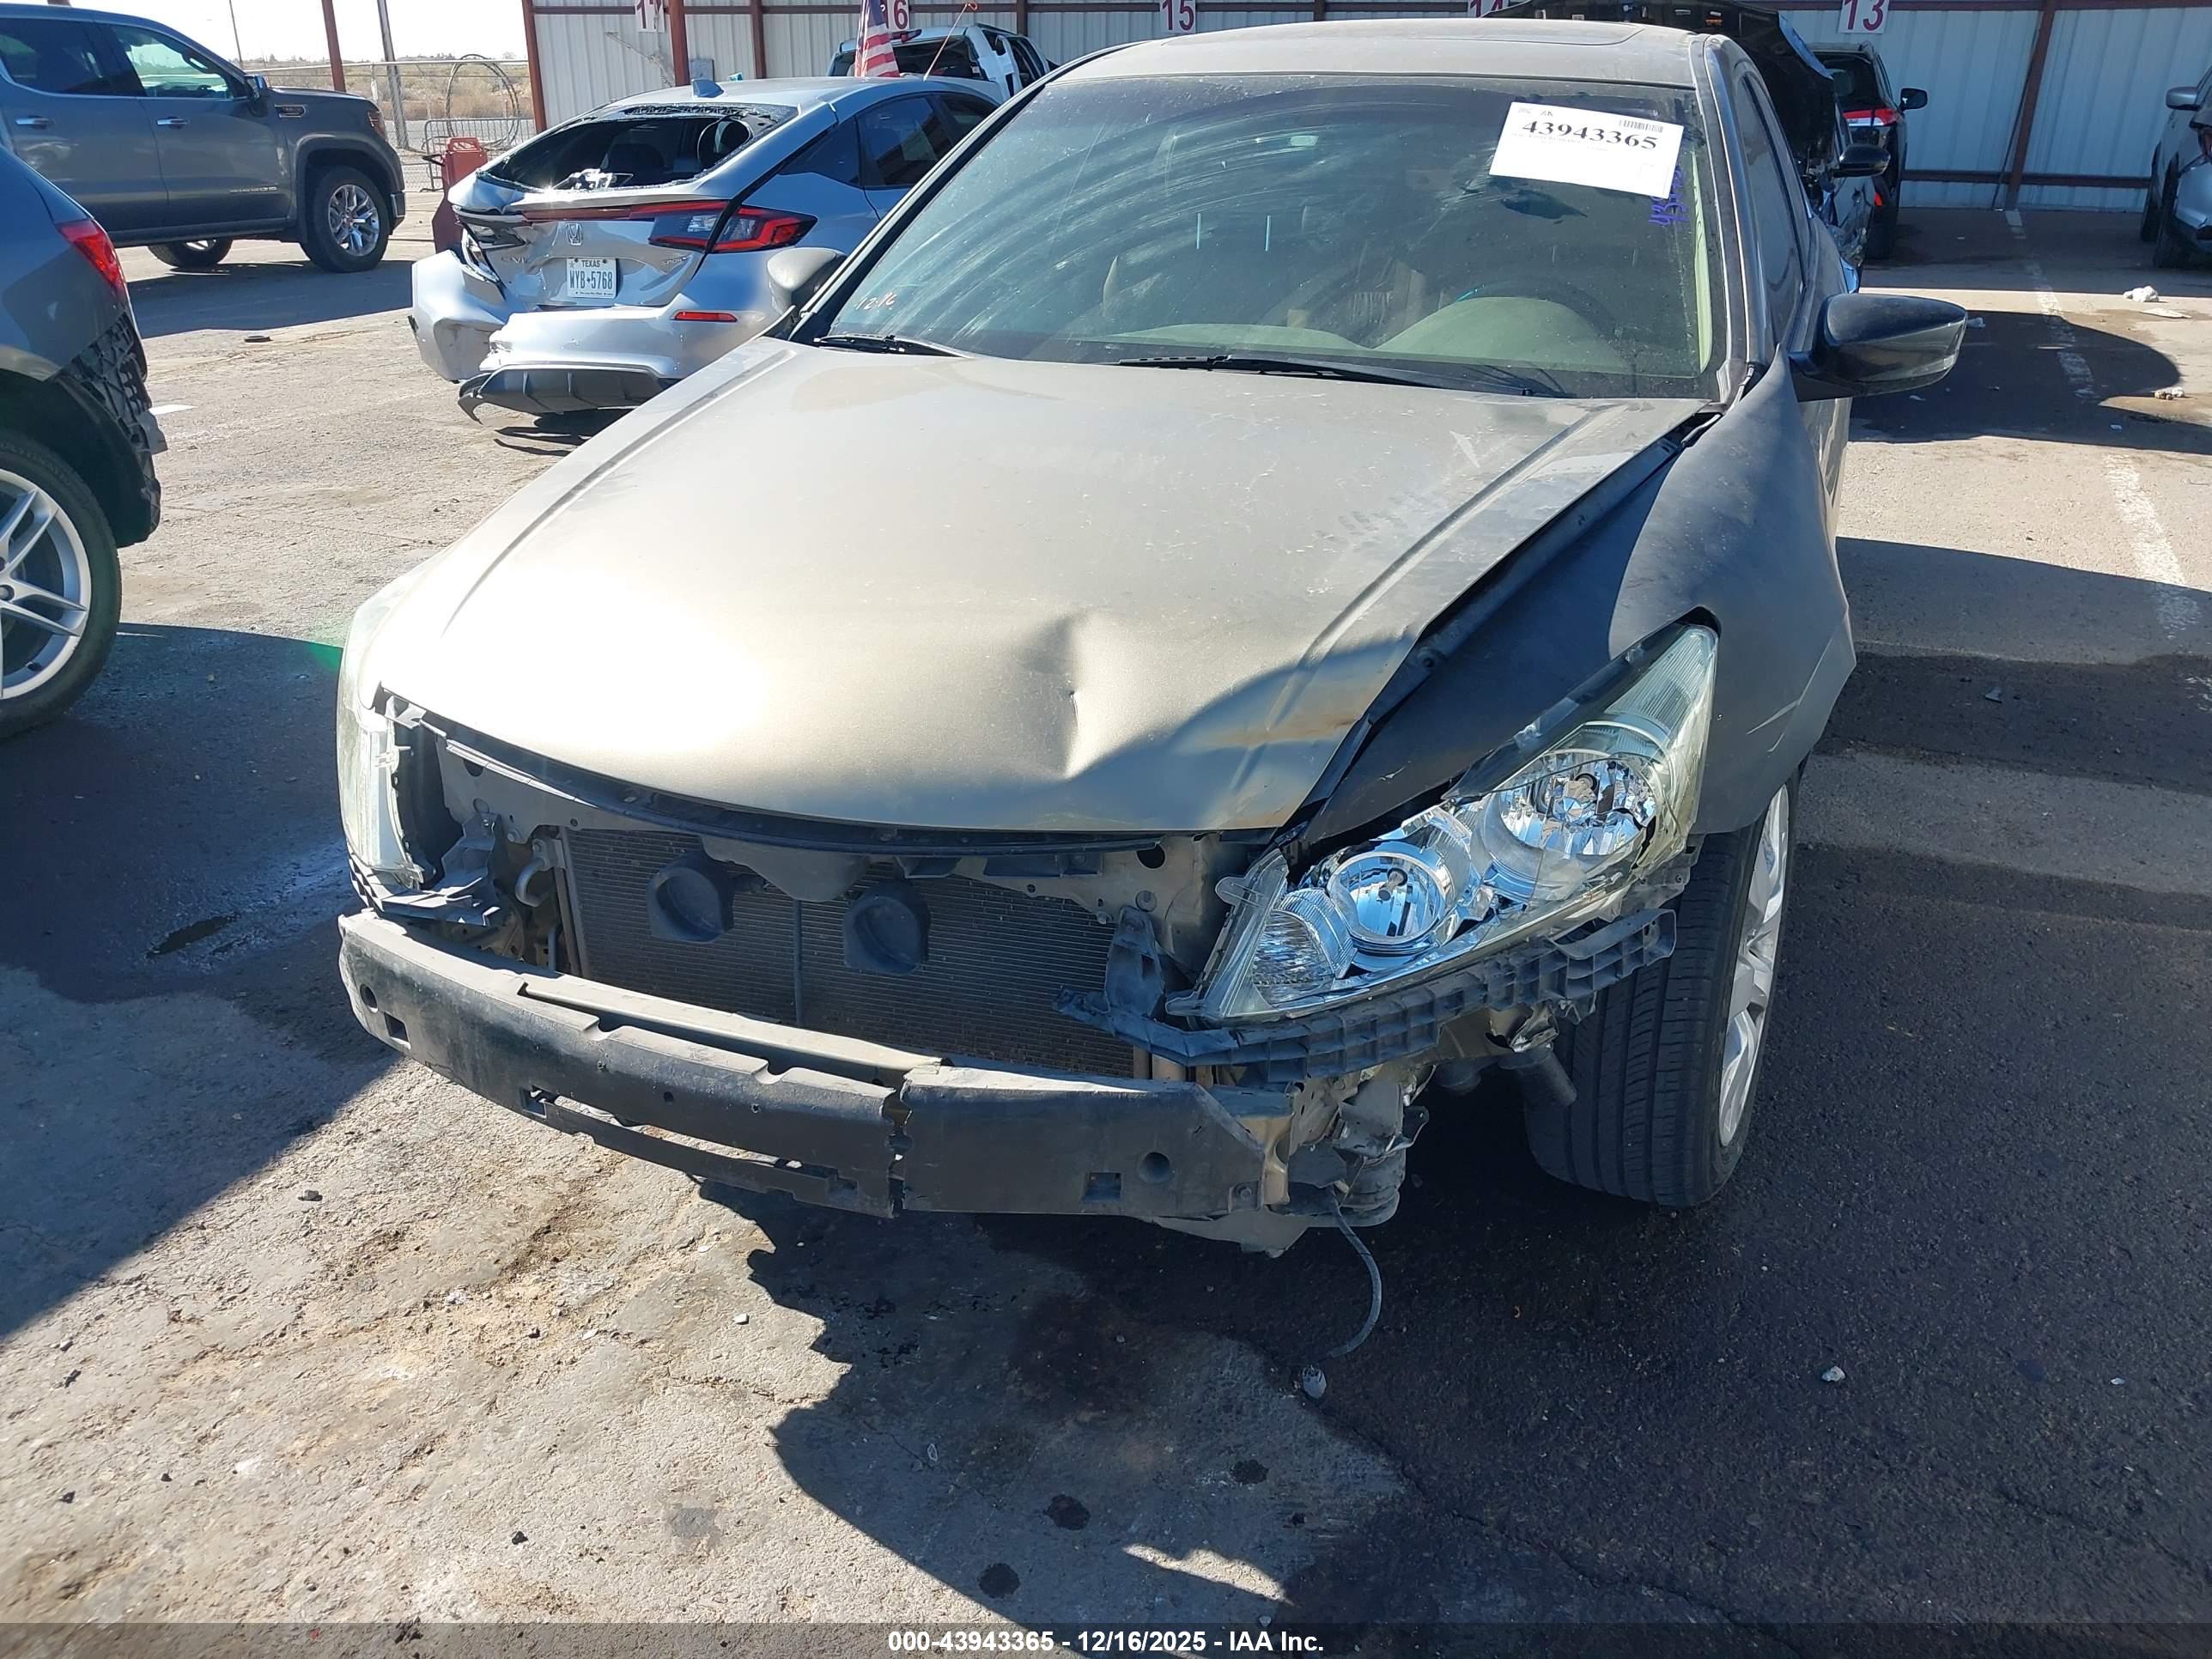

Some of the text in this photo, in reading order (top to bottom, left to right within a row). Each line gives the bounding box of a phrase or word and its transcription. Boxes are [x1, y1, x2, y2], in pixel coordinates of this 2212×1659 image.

[1162, 0, 1194, 31] 15
[1844, 0, 1884, 31] 13
[1522, 120, 1658, 149] 43943365
[581, 259, 600, 268] TEXAS
